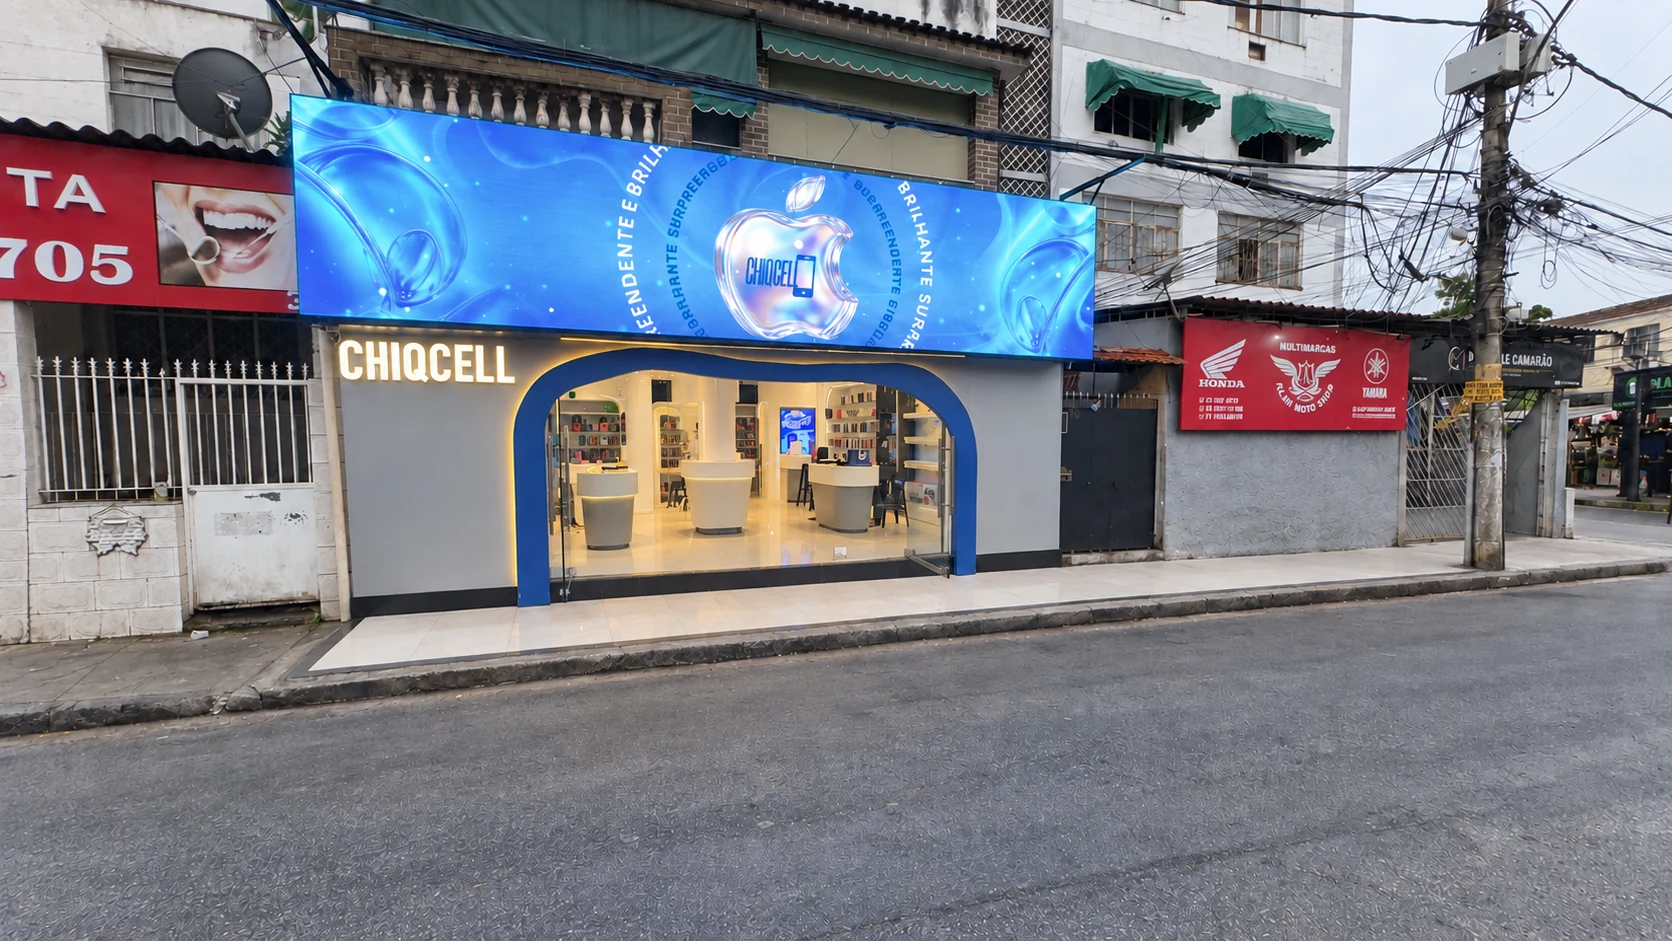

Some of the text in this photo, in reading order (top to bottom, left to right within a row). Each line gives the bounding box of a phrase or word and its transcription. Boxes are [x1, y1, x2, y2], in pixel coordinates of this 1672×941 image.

[6, 167, 106, 214] TA
[621, 199, 638, 212] E
[898, 181, 933, 287] BRILHANTE
[338, 339, 516, 383] CHIQCELL
[1199, 379, 1245, 389] HONDA
